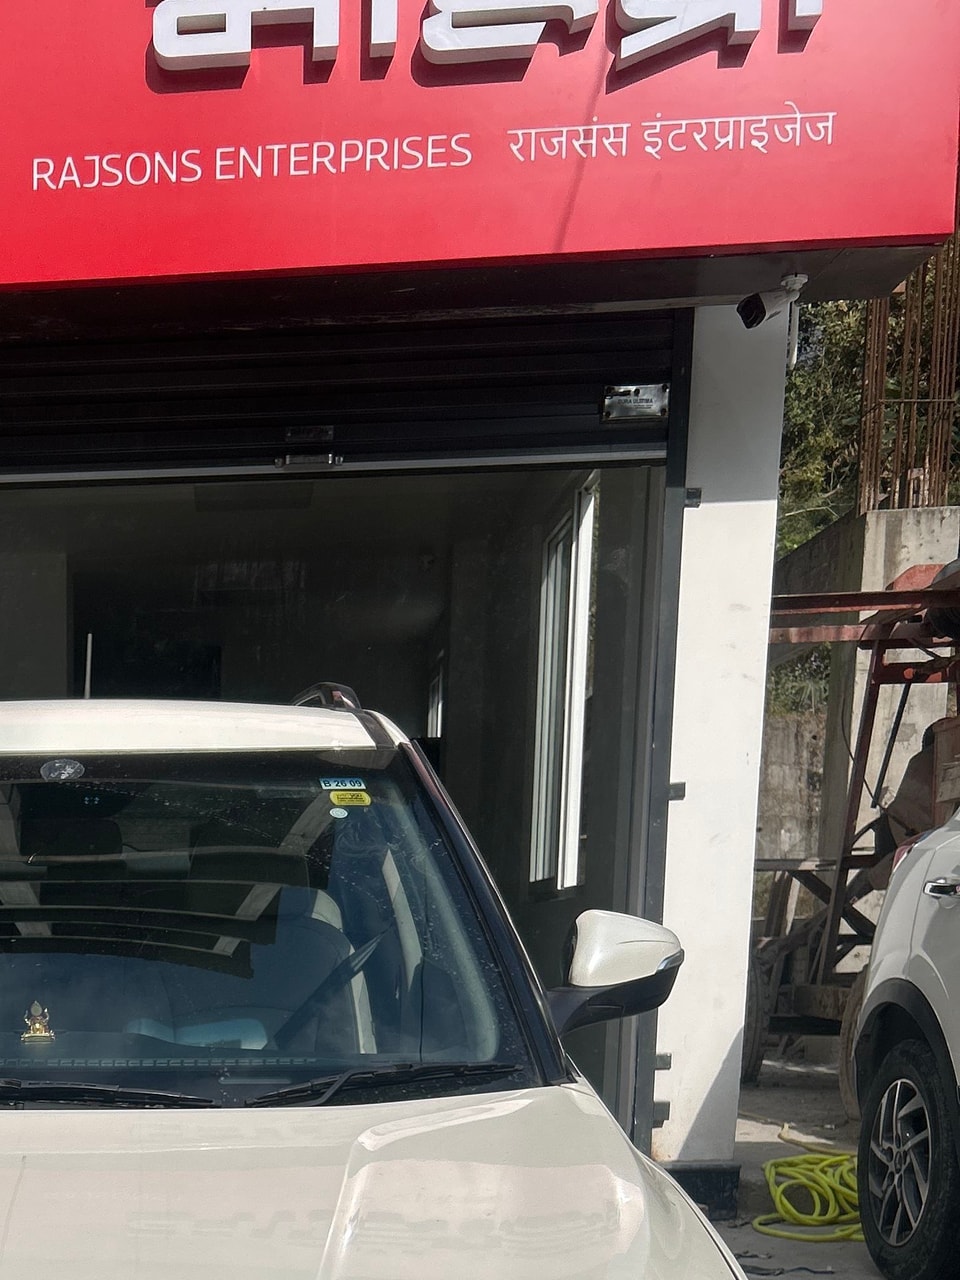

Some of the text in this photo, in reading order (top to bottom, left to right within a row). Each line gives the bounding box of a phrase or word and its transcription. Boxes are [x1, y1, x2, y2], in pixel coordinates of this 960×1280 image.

[507, 100, 838, 162] राजसंस इंटरप्राइजेज
[32, 133, 472, 190] RAJSONS ENTERPRISES
